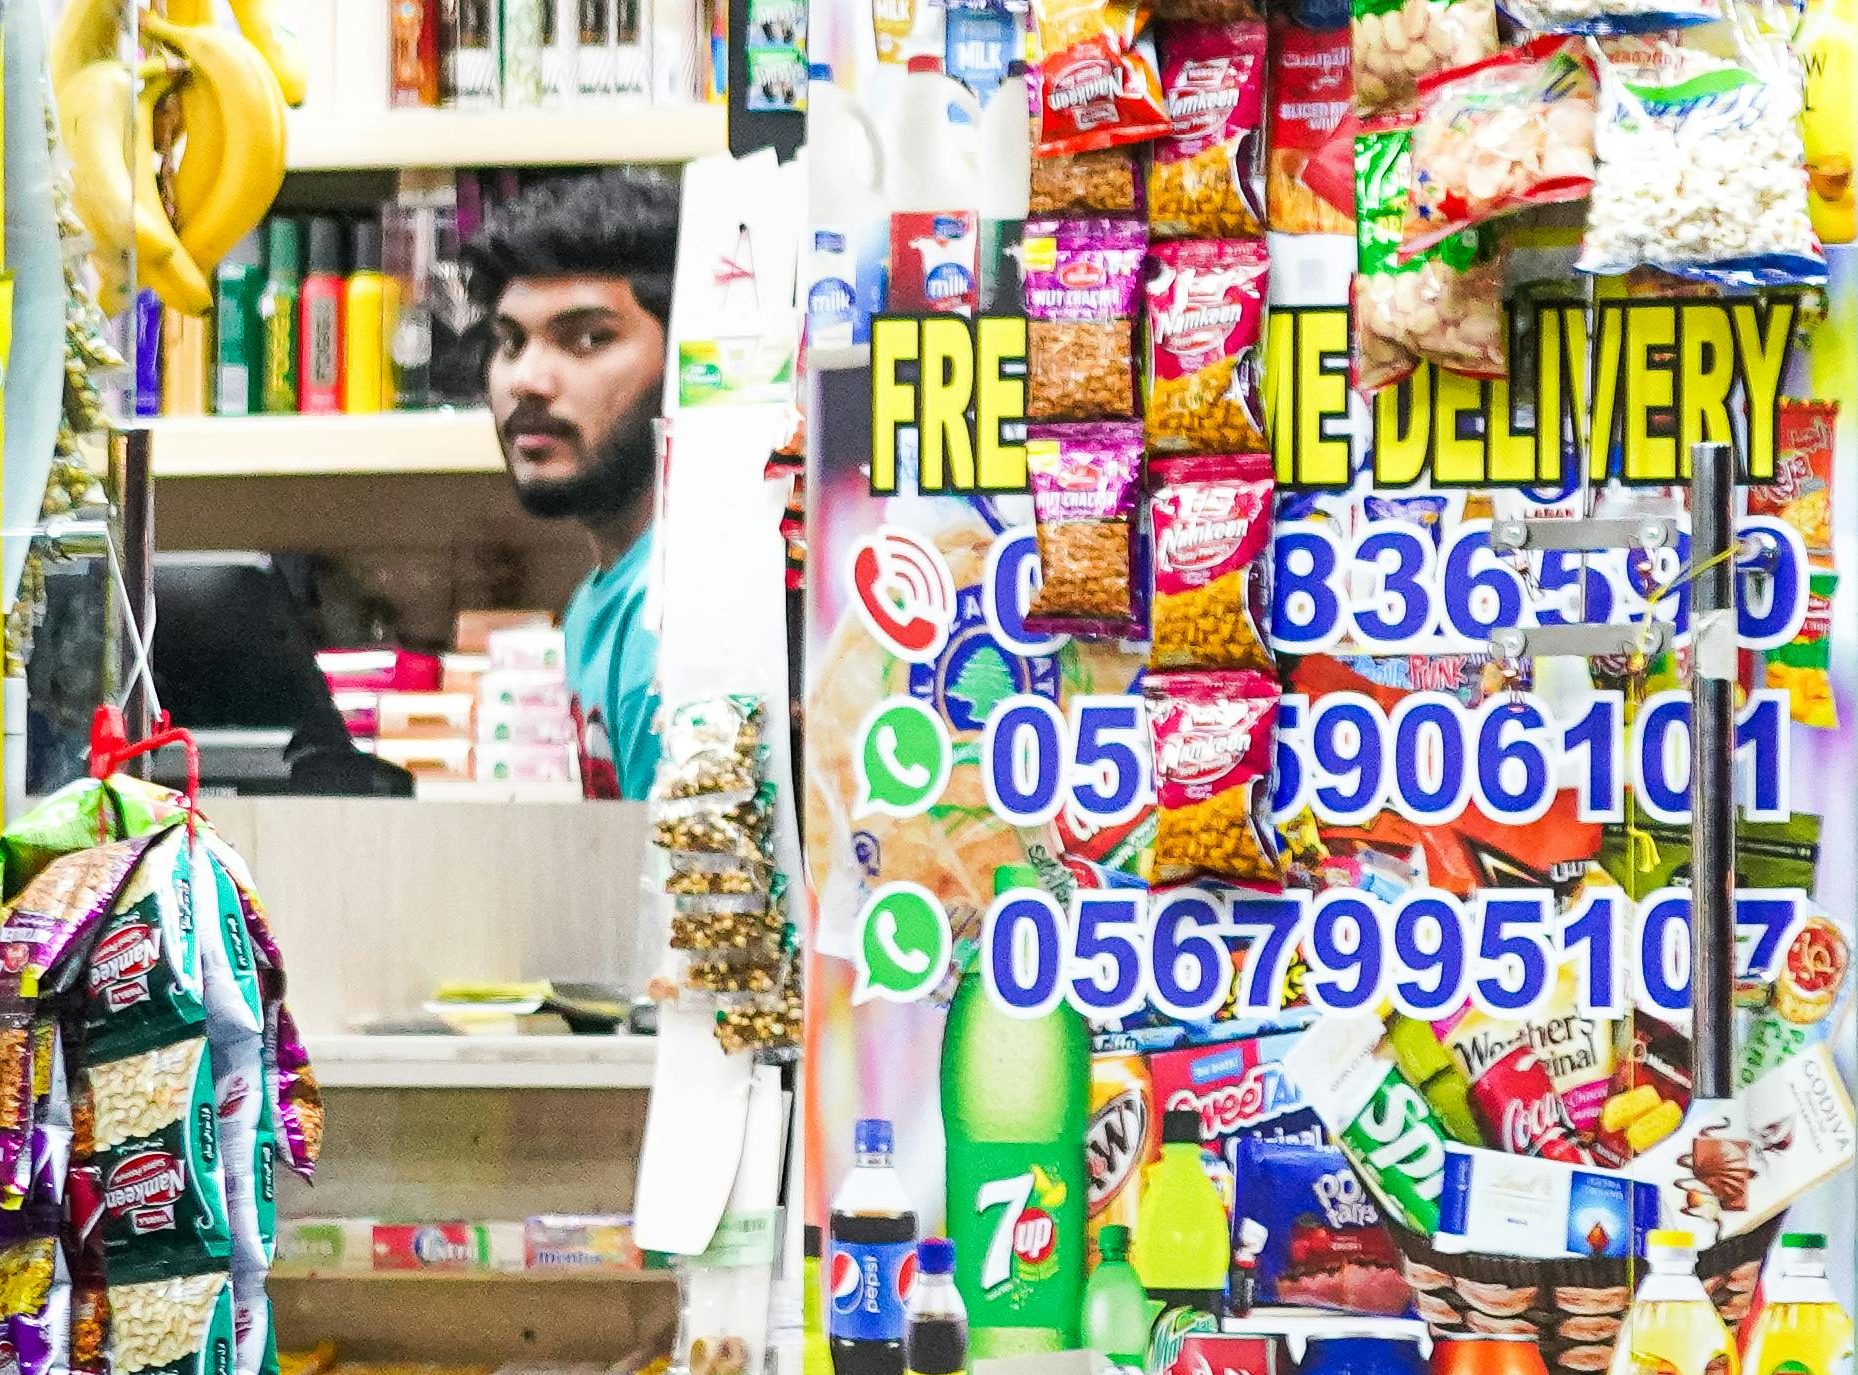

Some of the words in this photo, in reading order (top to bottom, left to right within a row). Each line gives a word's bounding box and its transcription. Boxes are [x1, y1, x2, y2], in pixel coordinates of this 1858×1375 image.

[958, 40, 1001, 69] MILK
[810, 291, 853, 315] milk
[929, 272, 972, 298] milk
[1157, 303, 1243, 339] Namkeen
[872, 312, 1029, 493] FRE
[1373, 302, 1798, 488] DELIVERY
[1159, 517, 1249, 560] Namkeen
[992, 527, 1802, 642] 0836590
[992, 701, 1782, 814] 05906101
[1164, 731, 1250, 766] Namkeen
[991, 898, 1798, 1011] 0567995107
[1804, 1059, 1853, 1153] GODIVA
[105, 1156, 186, 1216] Namkeen
